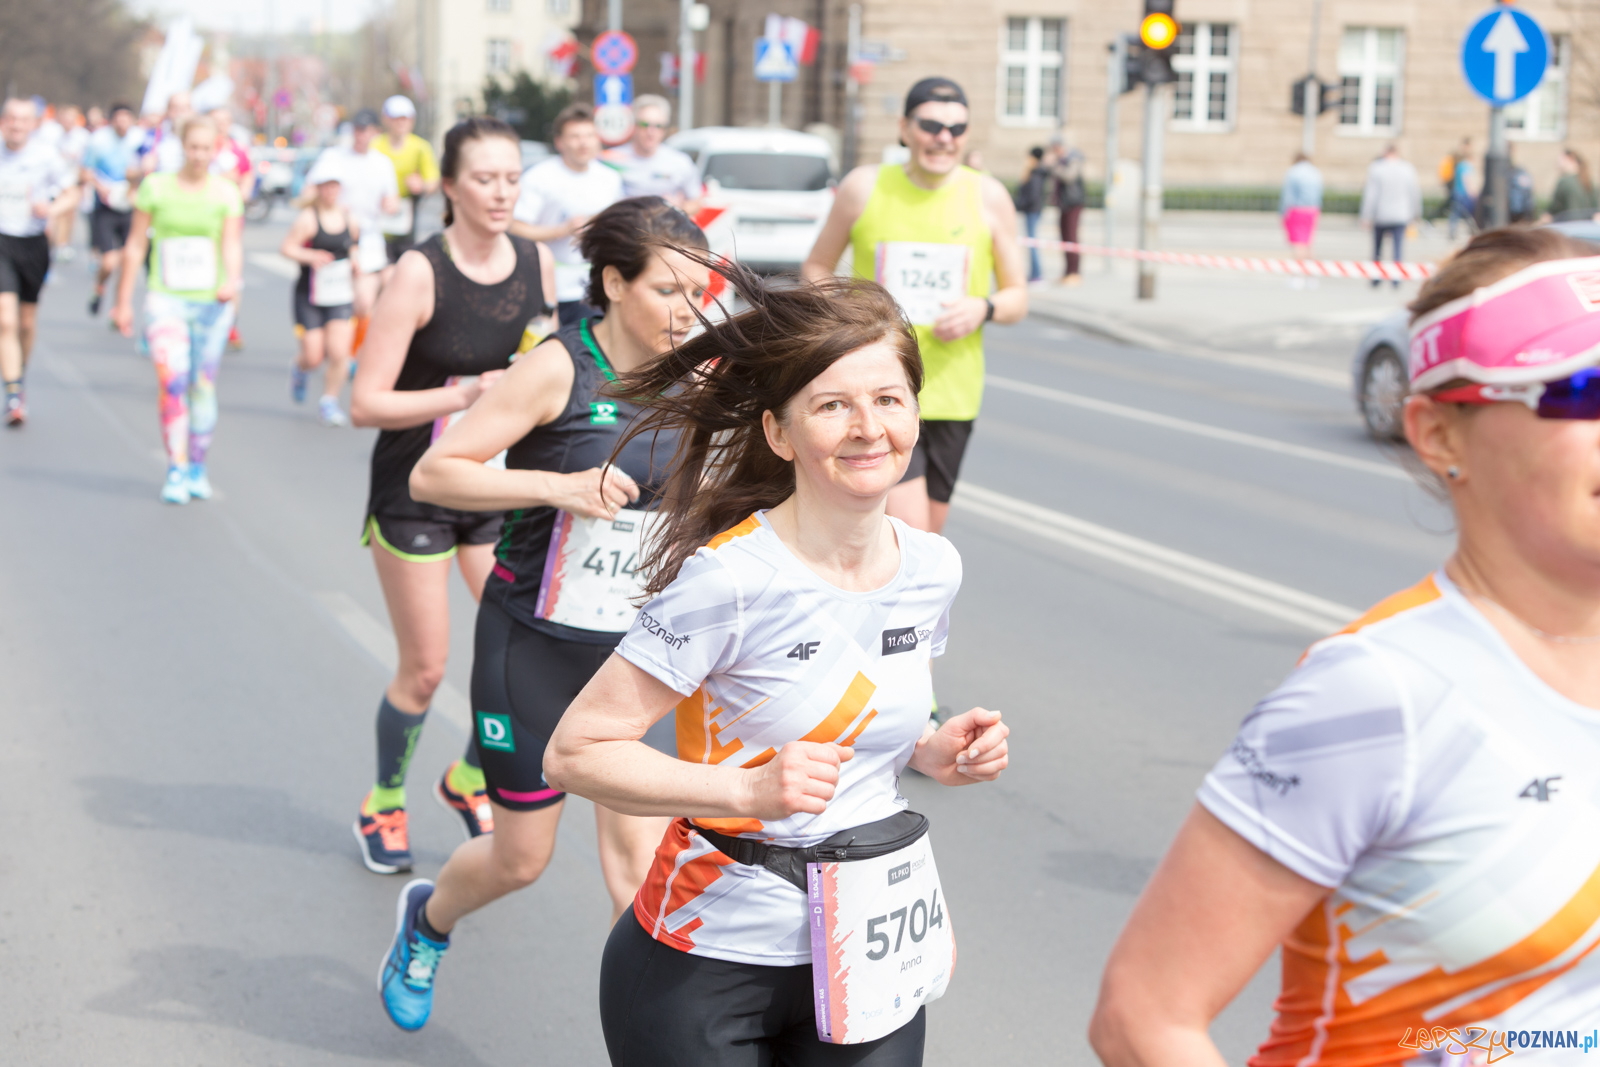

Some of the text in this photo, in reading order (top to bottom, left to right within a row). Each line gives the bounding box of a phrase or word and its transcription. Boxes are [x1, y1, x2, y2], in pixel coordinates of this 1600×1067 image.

[901, 269, 951, 291] 1245
[786, 641, 821, 661] 4F
[483, 717, 506, 741] D
[1518, 776, 1563, 802] 4F
[865, 887, 944, 961] 5704
[899, 955, 923, 974] Anna
